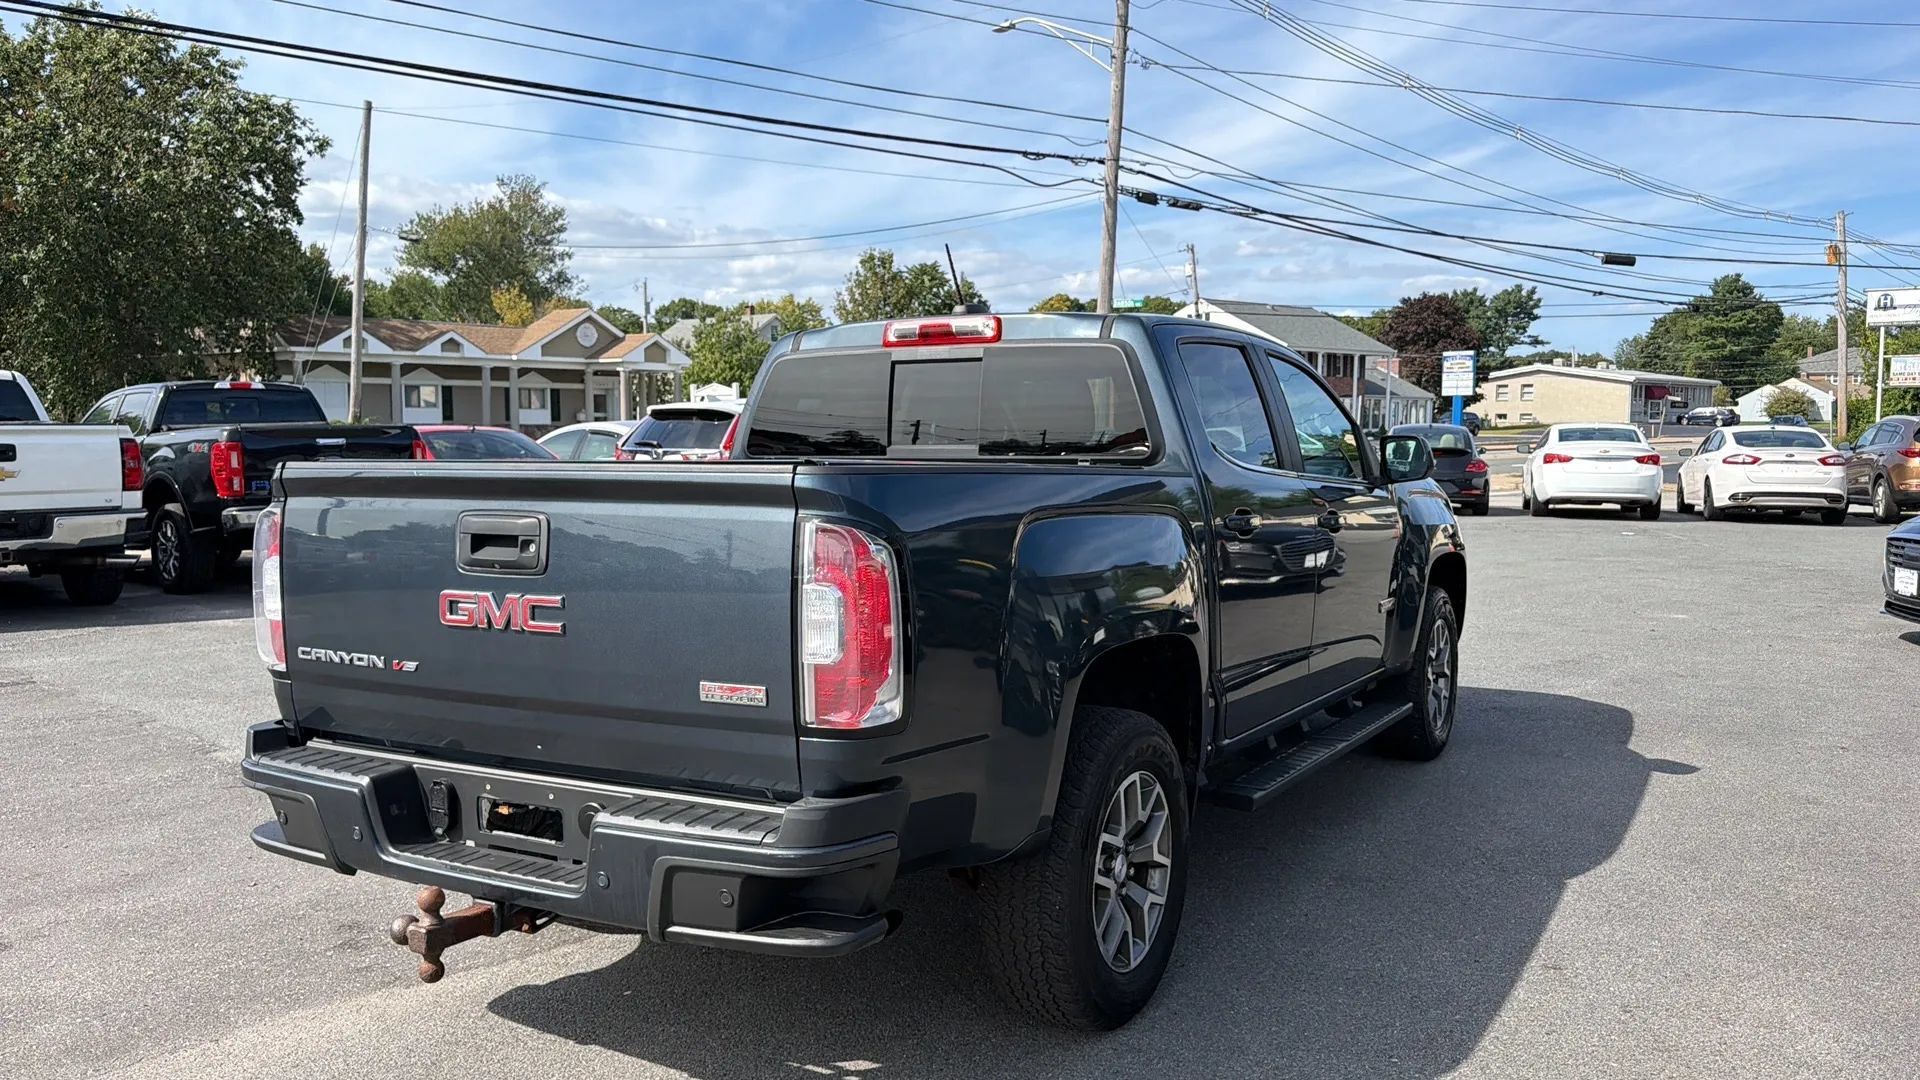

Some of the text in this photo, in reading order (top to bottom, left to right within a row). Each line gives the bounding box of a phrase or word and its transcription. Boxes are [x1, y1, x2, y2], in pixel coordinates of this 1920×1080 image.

[439, 589, 566, 635] GMC
[297, 646, 420, 672] CANYON V6
[704, 694, 764, 703] TERRAIN
